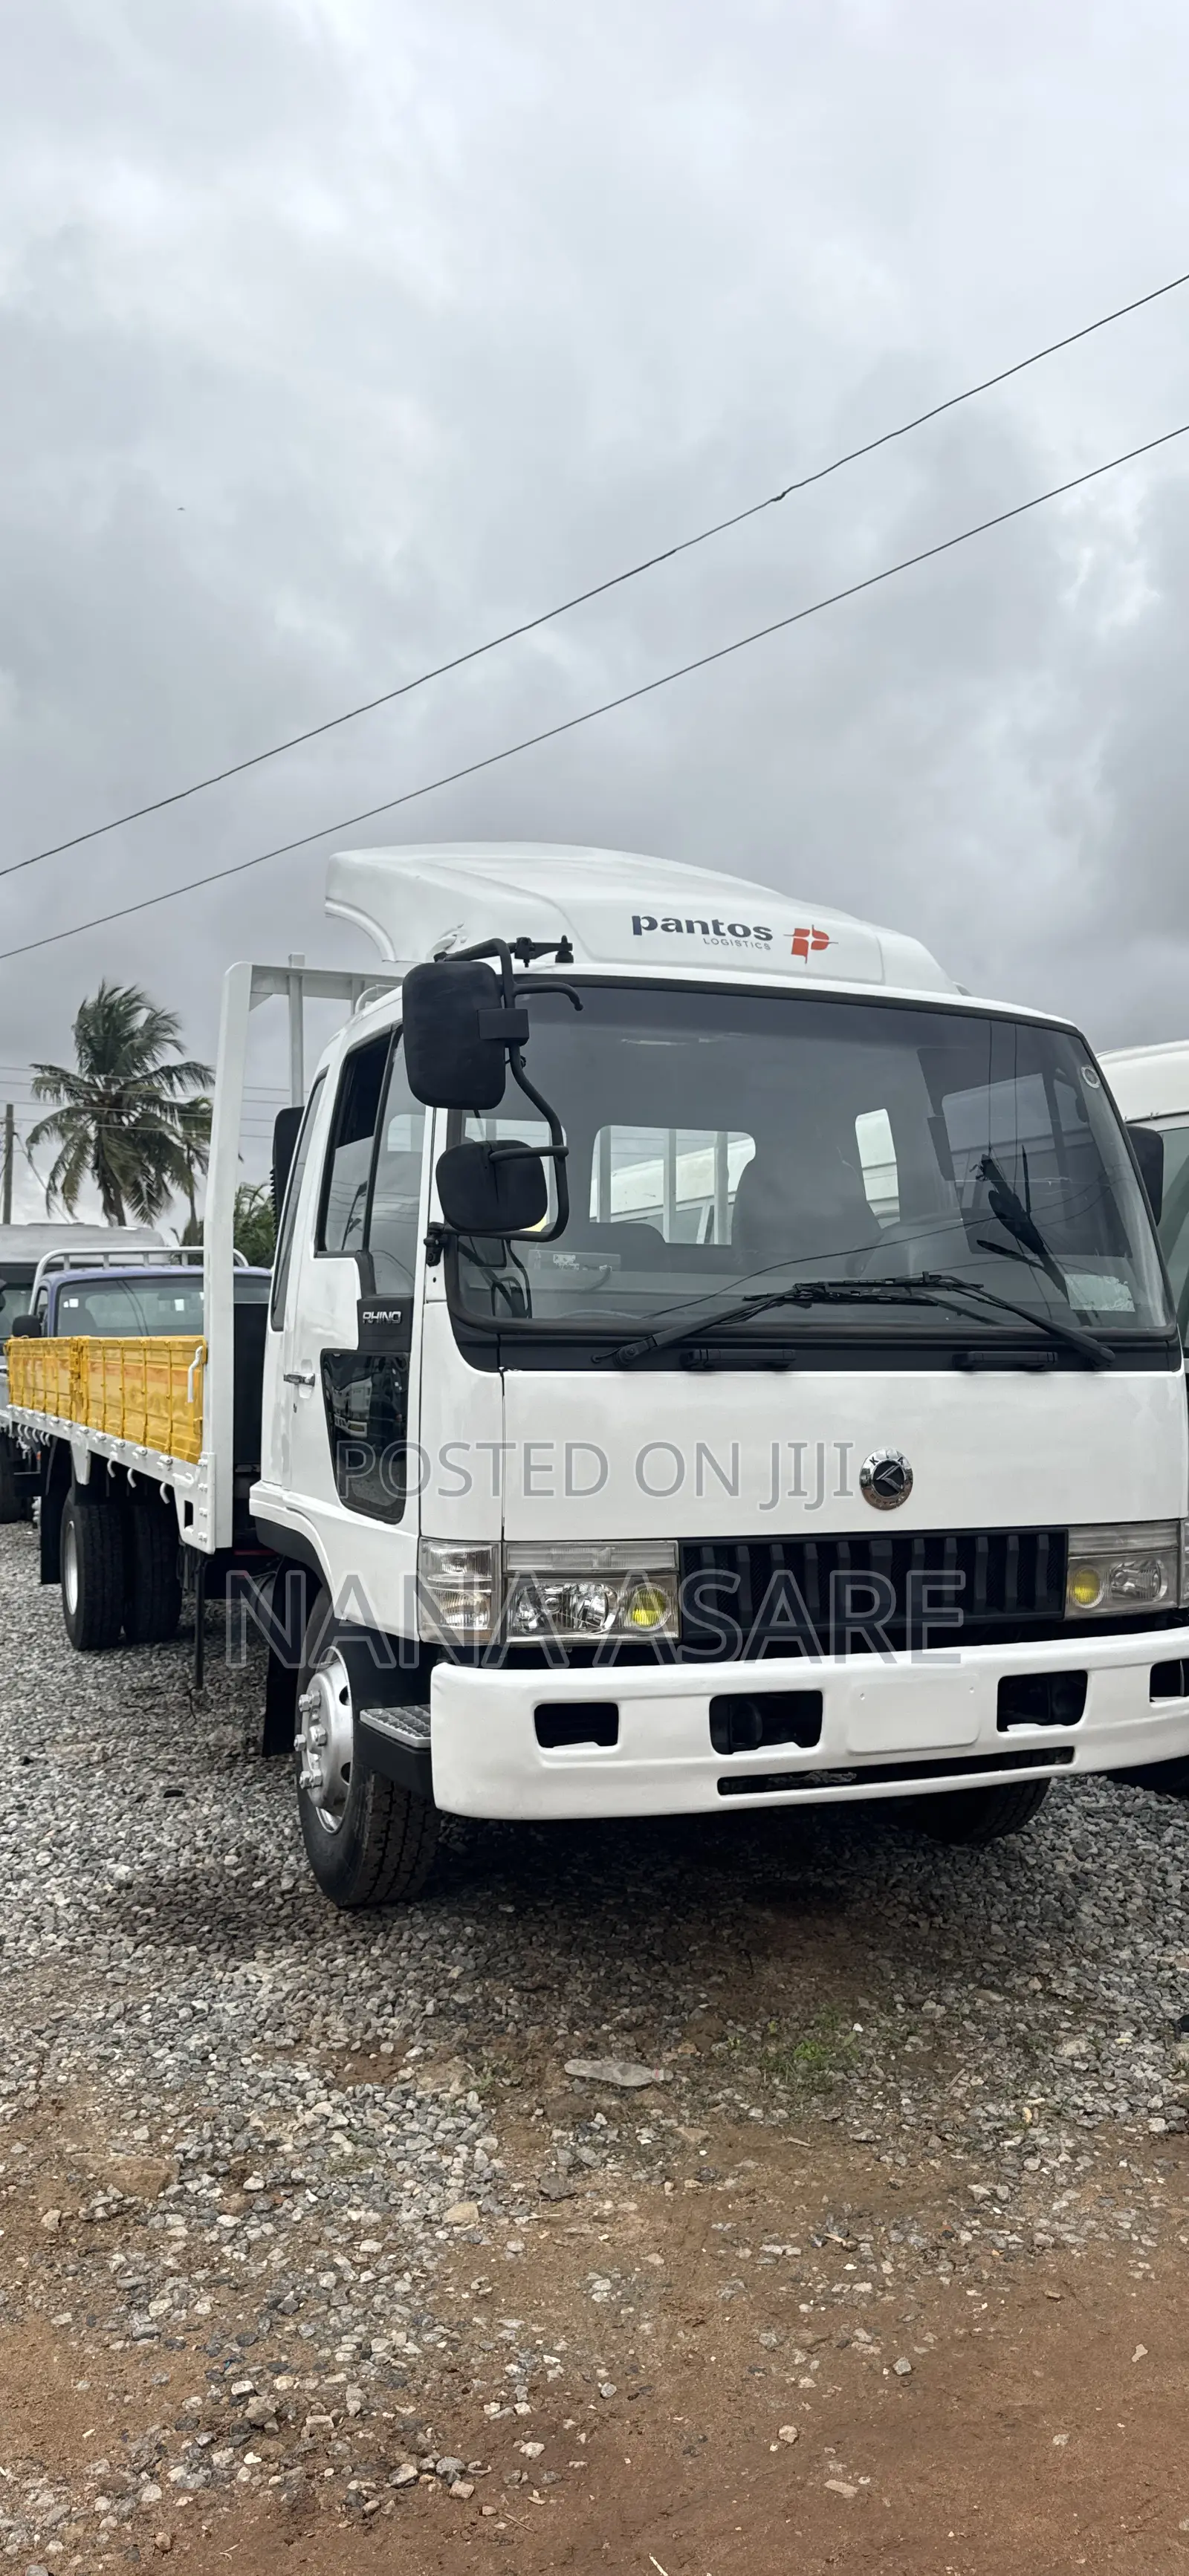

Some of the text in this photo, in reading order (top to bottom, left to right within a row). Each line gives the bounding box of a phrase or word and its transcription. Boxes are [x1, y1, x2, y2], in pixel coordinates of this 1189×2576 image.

[632, 915, 774, 941] pantos
[703, 938, 771, 951] LOGISTICS
[363, 1311, 401, 1324] RHINO
